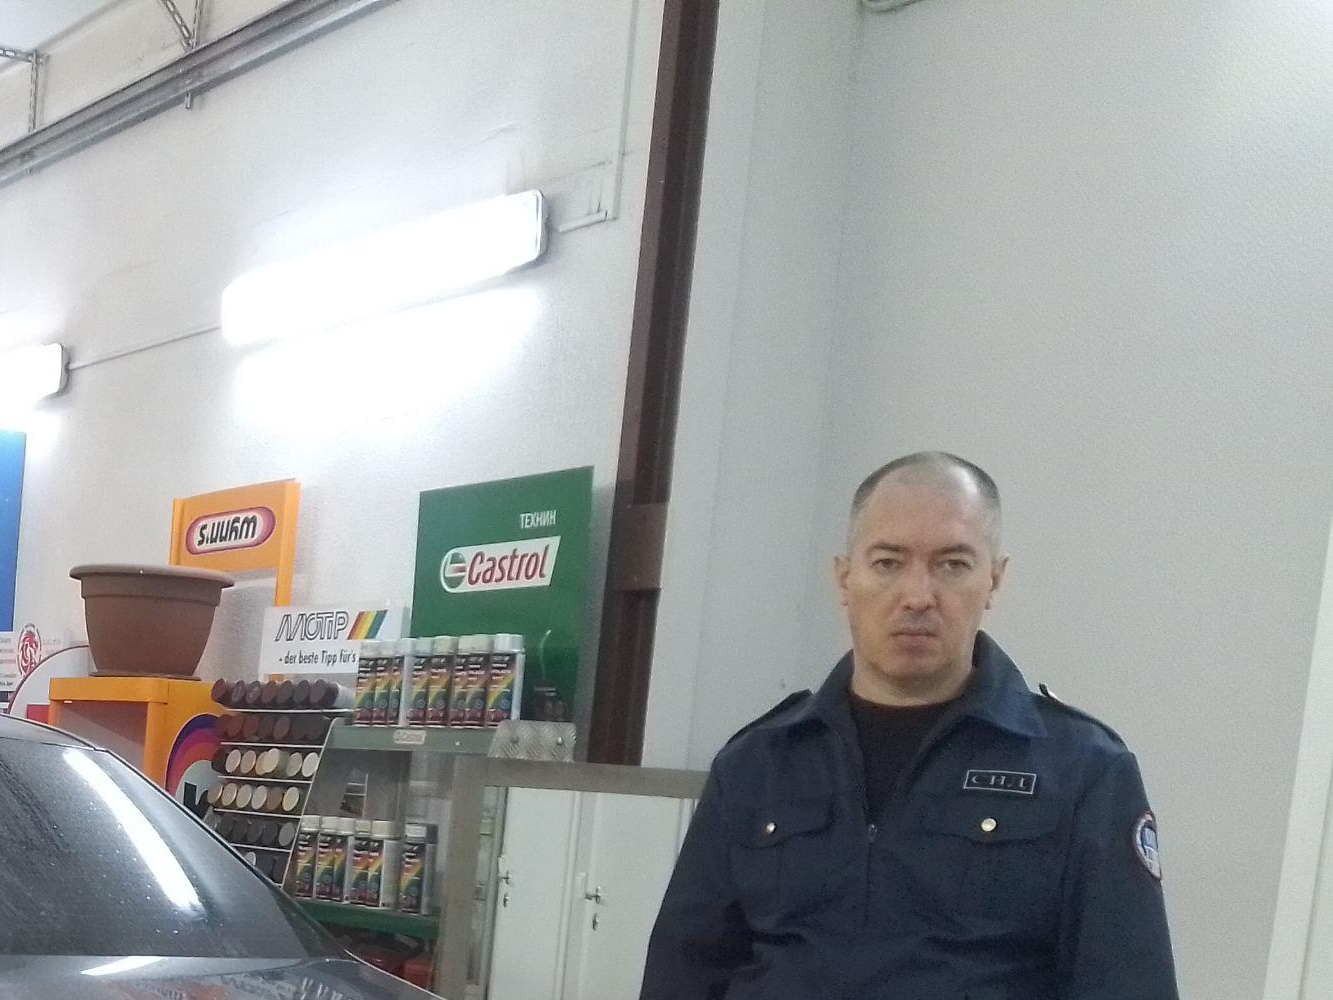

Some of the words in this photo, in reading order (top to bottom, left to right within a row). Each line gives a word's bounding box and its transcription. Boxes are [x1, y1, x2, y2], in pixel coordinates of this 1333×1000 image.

[468, 544, 550, 586] Castrol
[284, 650, 297, 664] der
[299, 650, 319, 664] beste
[321, 649, 338, 667] Tipp
